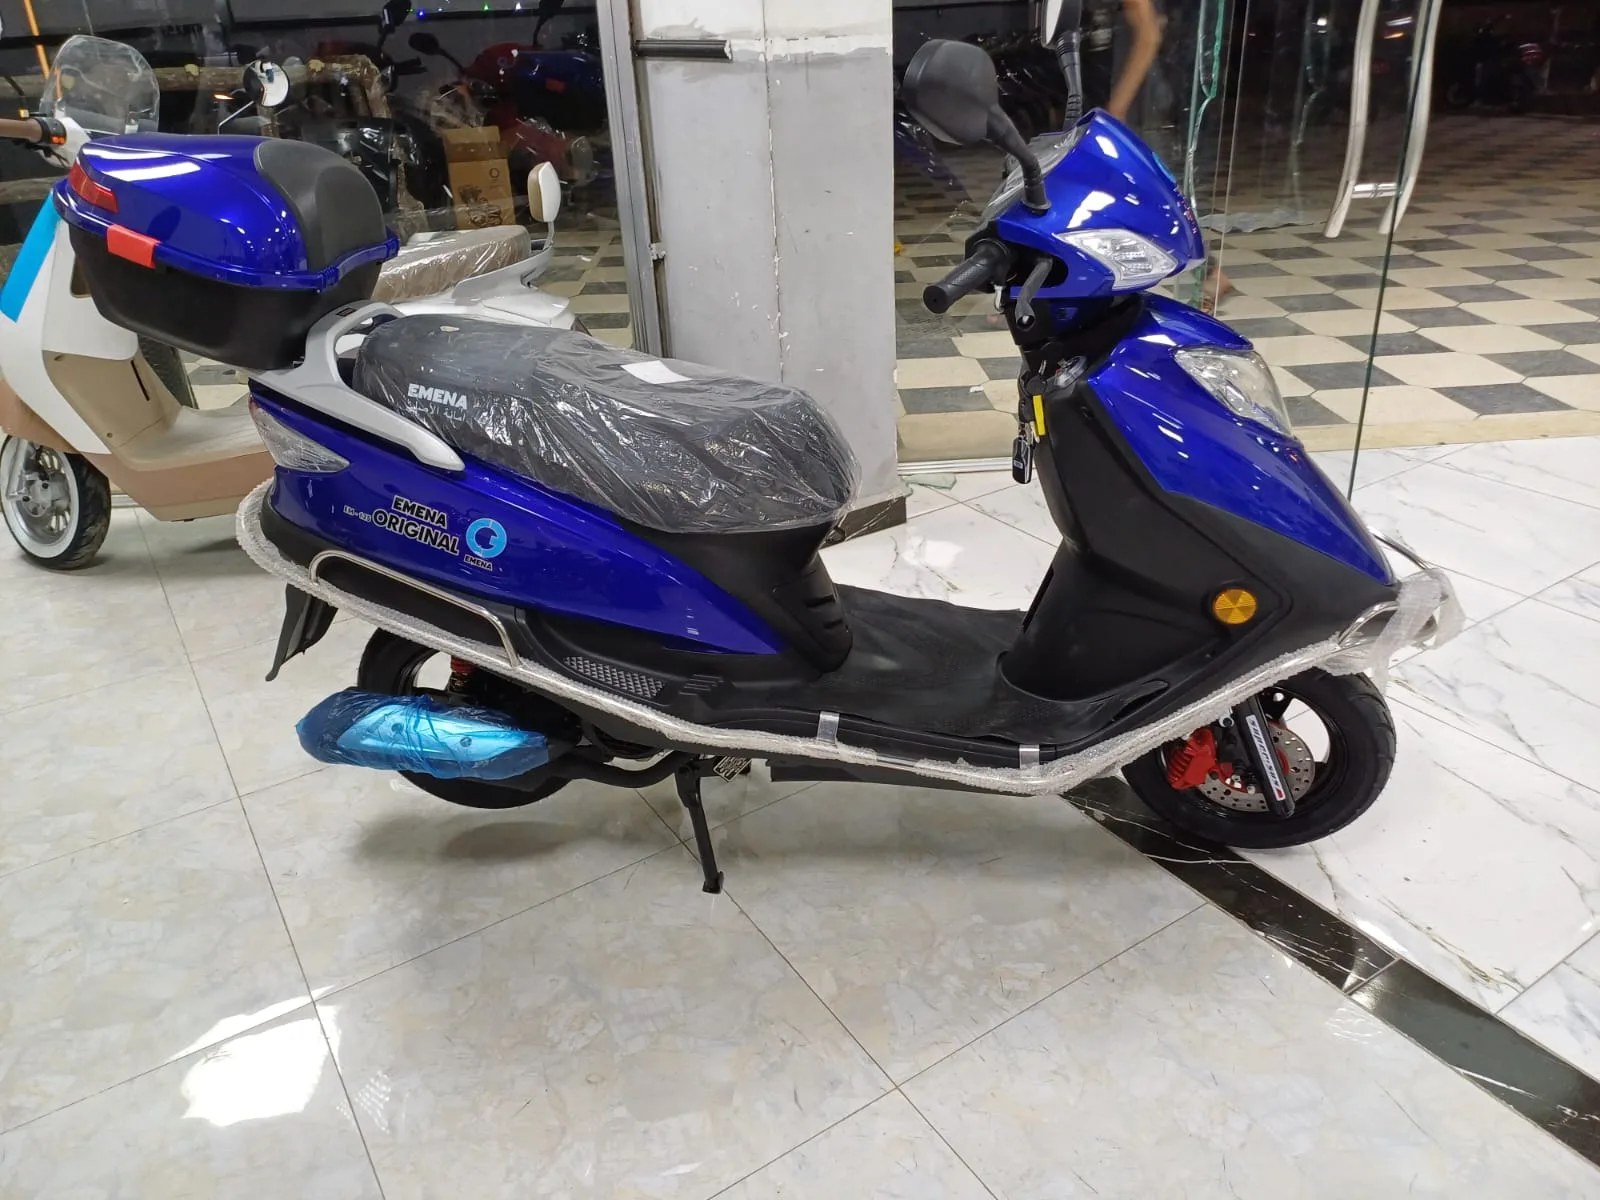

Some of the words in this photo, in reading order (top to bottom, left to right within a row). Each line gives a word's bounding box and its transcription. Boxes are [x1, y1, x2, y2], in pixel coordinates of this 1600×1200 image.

[408, 384, 468, 410] EMENA
[393, 495, 447, 529] EMENA
[372, 508, 459, 556] ORIGINAL
[465, 554, 493, 571] EMENA
